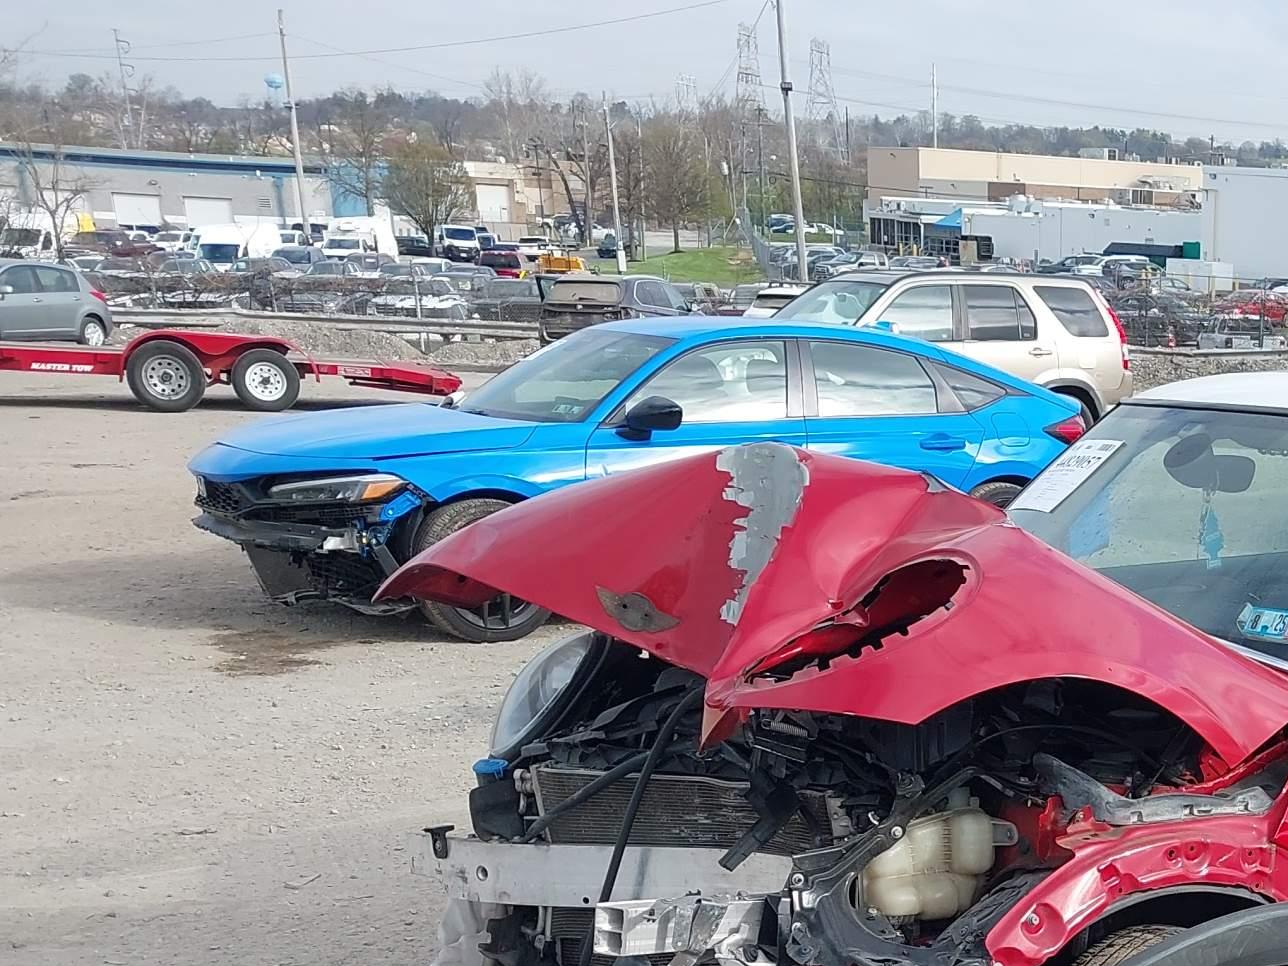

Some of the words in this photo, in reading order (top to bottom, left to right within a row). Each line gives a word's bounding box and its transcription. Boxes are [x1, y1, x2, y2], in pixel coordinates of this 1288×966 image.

[31, 362, 70, 371] MASTER
[1251, 614, 1261, 629] 8
[1274, 614, 1288, 632] 25
